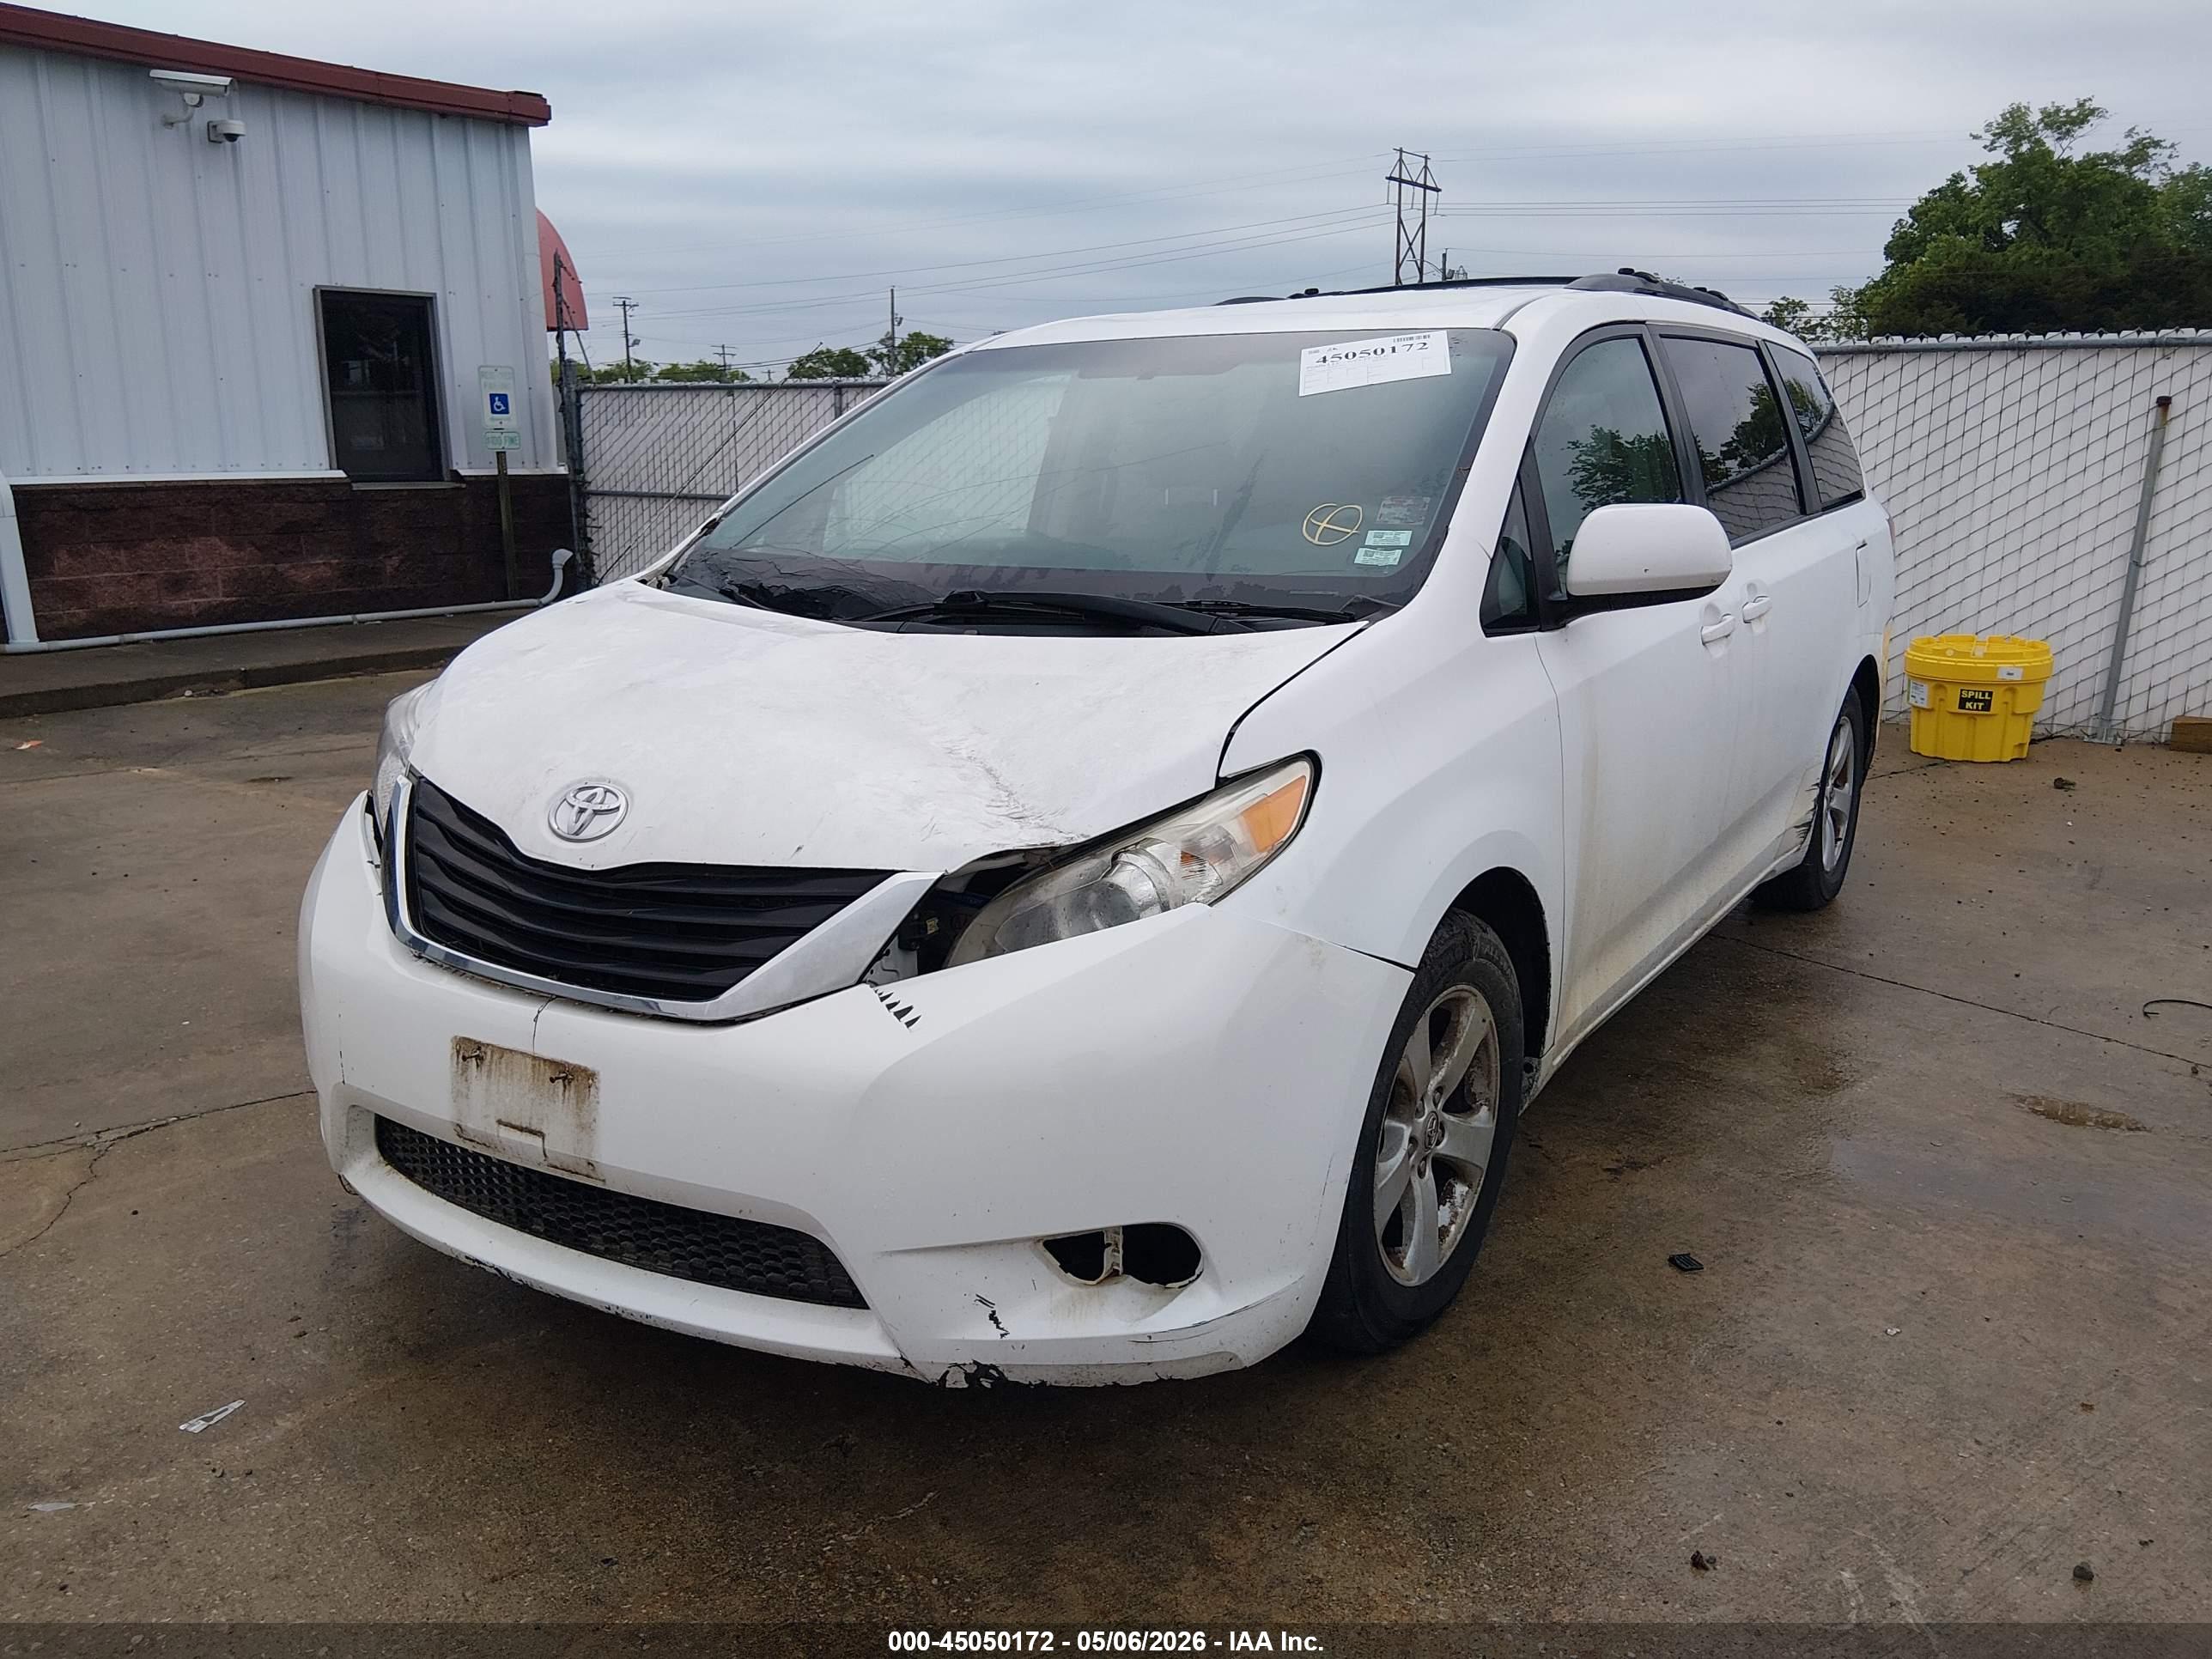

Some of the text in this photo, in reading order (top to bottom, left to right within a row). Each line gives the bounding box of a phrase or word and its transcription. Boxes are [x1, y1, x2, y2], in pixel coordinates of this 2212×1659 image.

[1315, 342, 1430, 364] 45050172
[1960, 690, 1991, 700] SPILL
[1966, 701, 1985, 710] KIT
